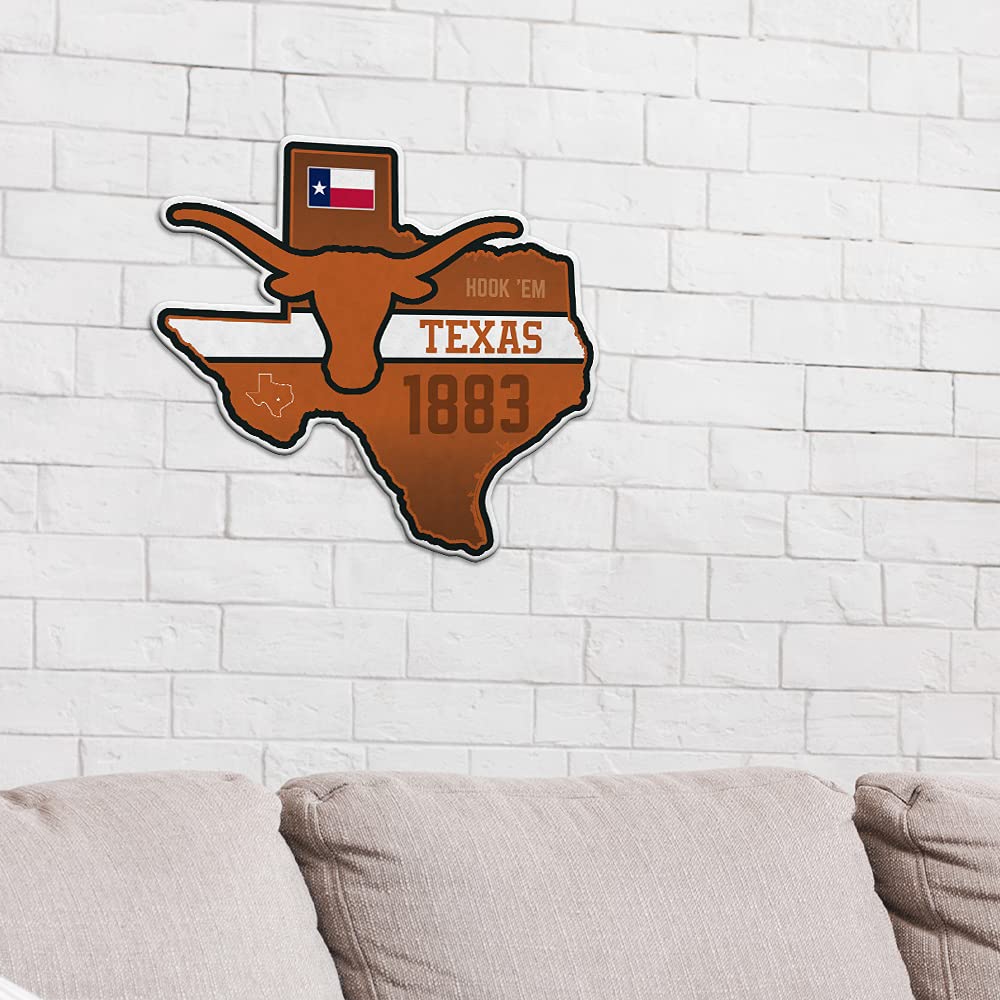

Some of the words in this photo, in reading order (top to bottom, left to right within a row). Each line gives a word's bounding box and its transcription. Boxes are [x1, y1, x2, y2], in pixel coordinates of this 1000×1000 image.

[466, 277, 510, 298] HOOK
[419, 319, 542, 354] TEXAS
[403, 374, 530, 435] 1883
